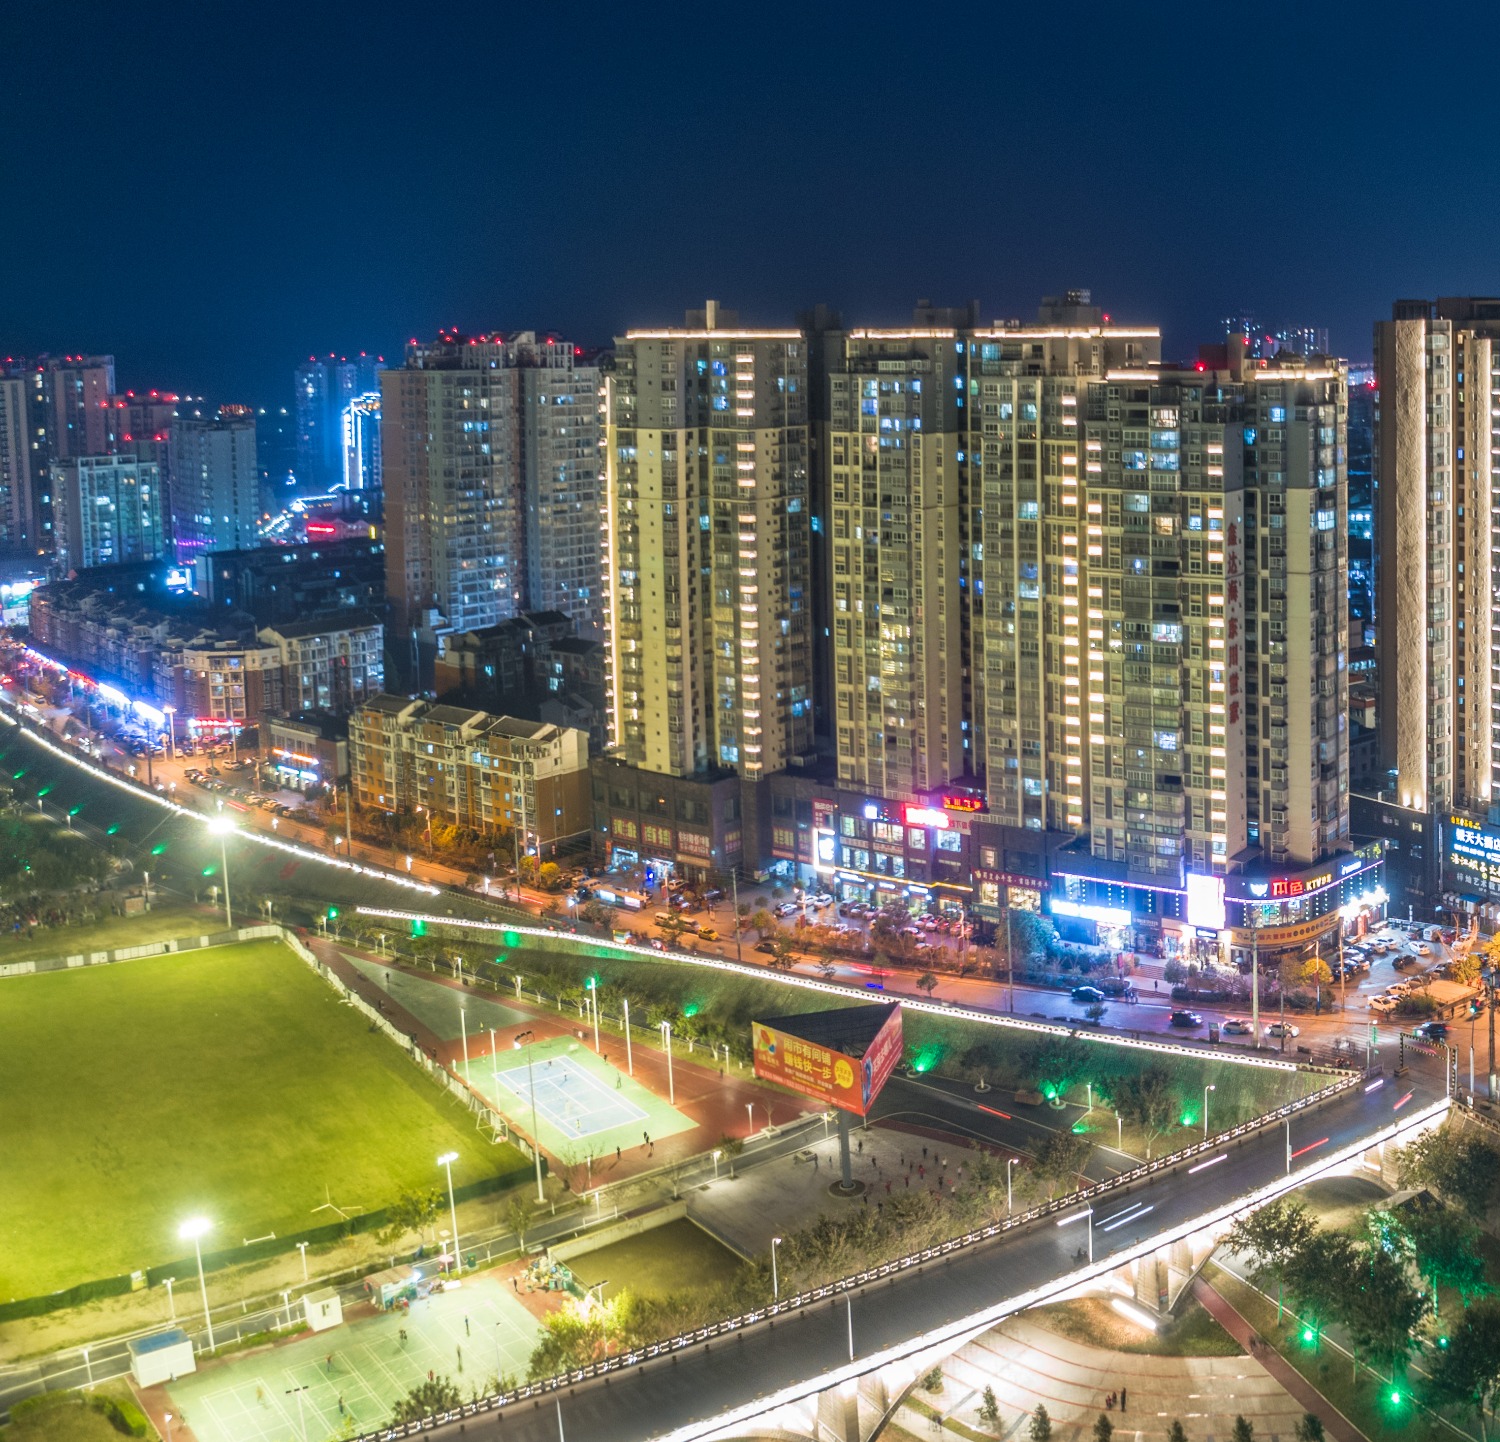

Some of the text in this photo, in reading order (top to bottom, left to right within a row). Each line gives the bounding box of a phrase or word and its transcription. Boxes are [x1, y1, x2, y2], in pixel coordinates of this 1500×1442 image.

[1272, 881, 1303, 896] 本色
[783, 1038, 831, 1065] 闹市有间铺
[783, 1052, 832, 1079] 赚钱快一步
